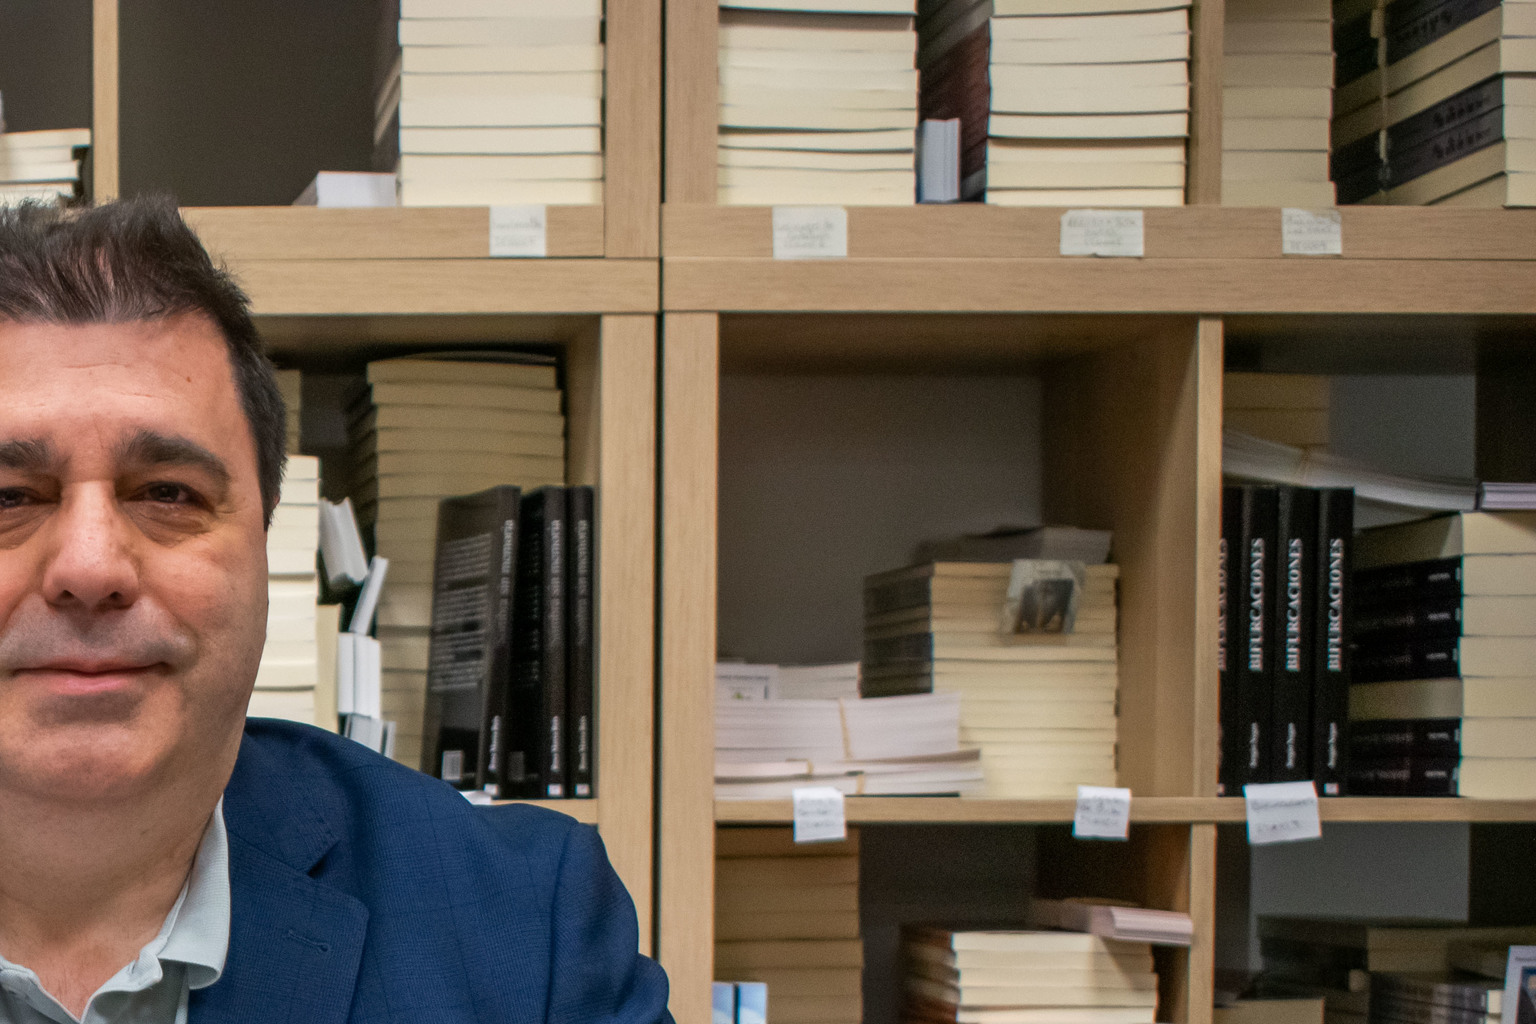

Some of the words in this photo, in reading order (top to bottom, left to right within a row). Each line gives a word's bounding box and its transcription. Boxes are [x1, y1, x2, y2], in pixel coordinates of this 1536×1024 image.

[1249, 537, 1265, 672] BIFURCACIONES
[1285, 537, 1302, 672] BIFURCACIONES
[1327, 537, 1344, 672] BIFURCACIONES
